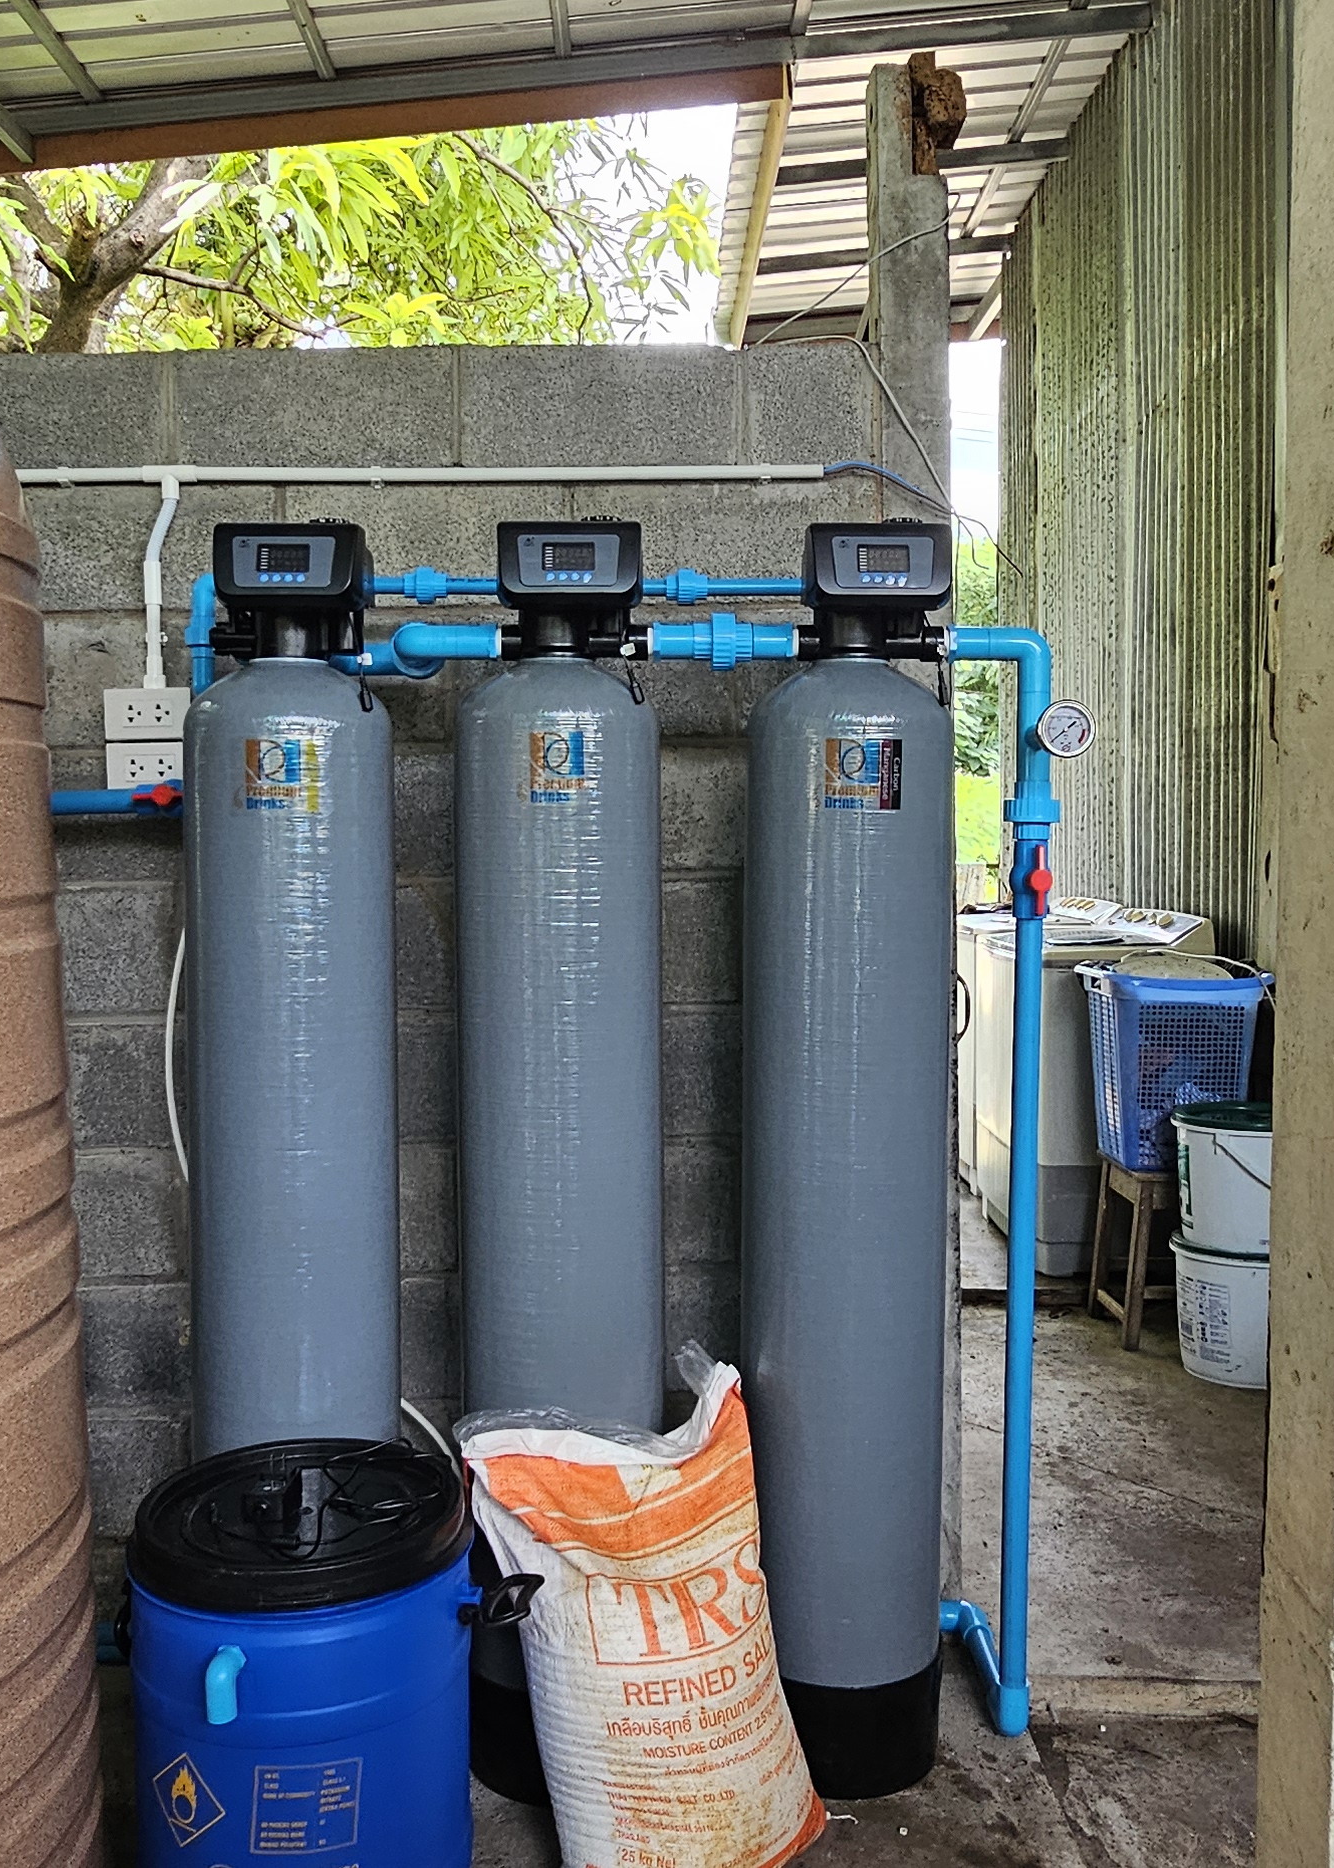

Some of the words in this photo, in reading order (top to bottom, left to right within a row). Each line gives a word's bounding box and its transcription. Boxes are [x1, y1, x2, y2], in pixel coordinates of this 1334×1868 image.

[892, 757, 901, 791] Carbon
[611, 1537, 765, 1658] TRS
[622, 1664, 737, 1706] REFINED
[606, 1710, 693, 1741] เกลือบริสุทธิ์
[643, 1742, 708, 1759] MOISTURE
[709, 1721, 753, 1750] CONTENT
[621, 1848, 636, 1863] 25
[639, 1850, 653, 1867] kg
